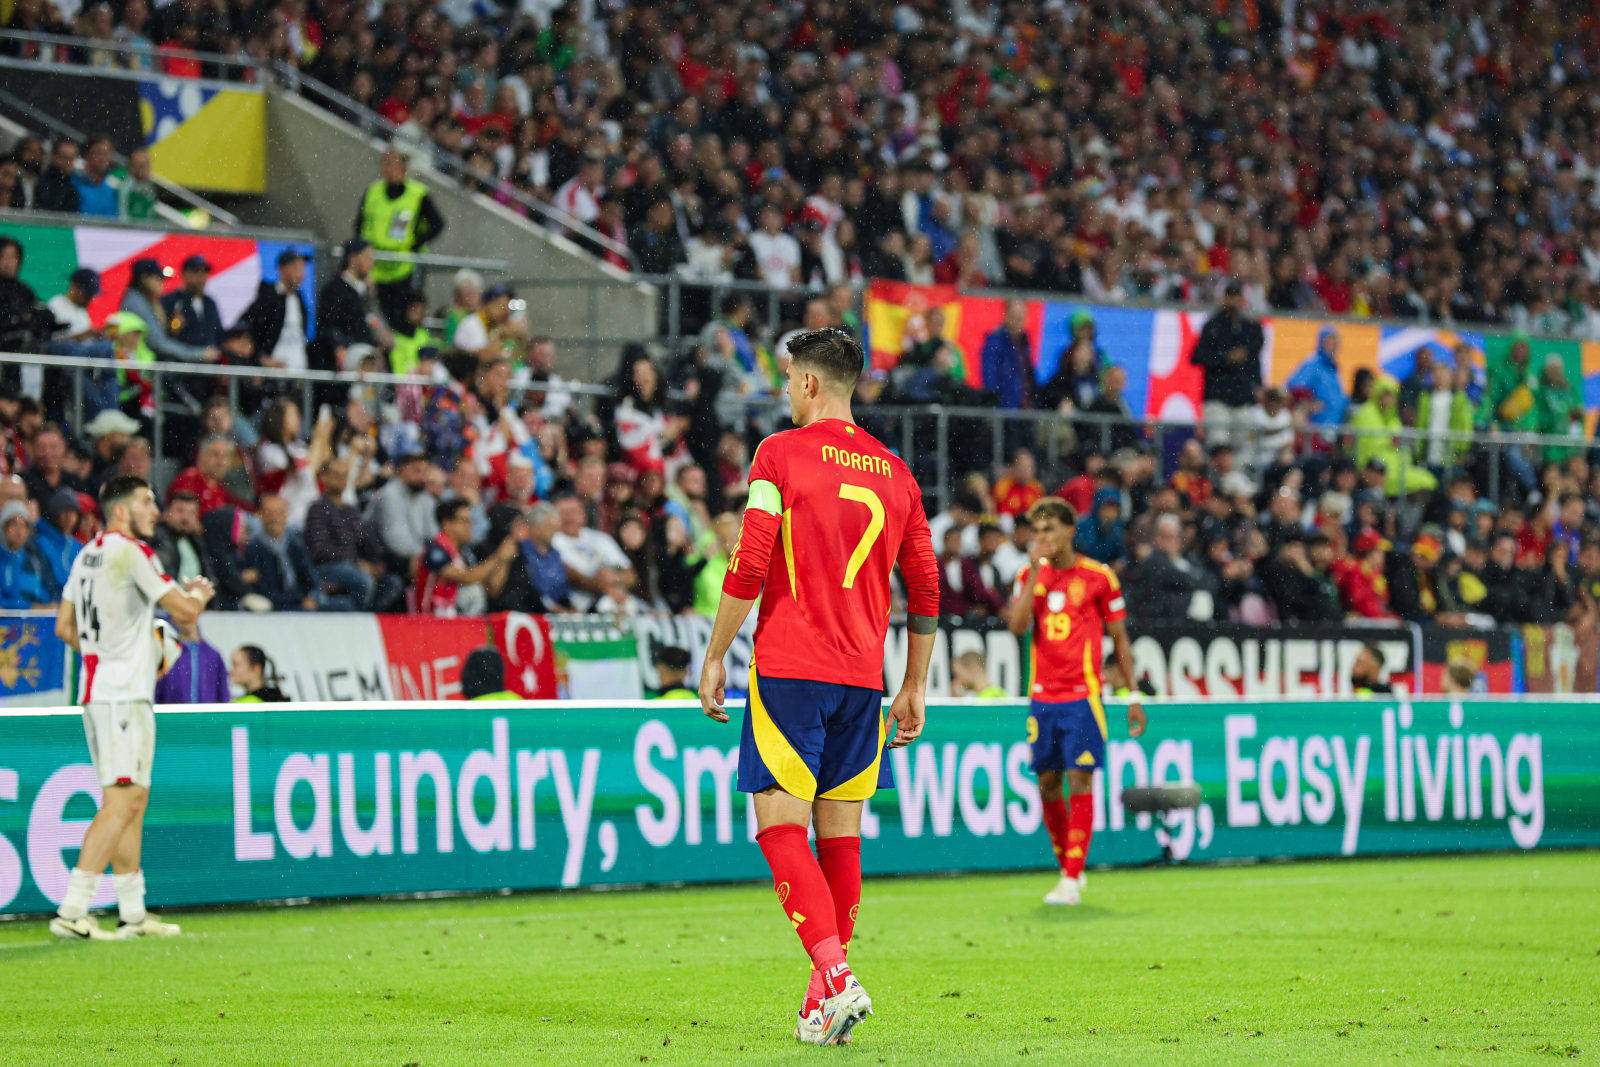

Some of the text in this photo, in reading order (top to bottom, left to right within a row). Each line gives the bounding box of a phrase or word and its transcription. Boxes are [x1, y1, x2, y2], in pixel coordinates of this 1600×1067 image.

[822, 445, 892, 478] MORATA
[838, 483, 886, 589] 7
[1044, 612, 1071, 641] 19
[231, 717, 619, 887] Laundry,
[892, 737, 1214, 861] wasing,
[1224, 714, 1371, 855] Easy
[1382, 701, 1545, 849] living
